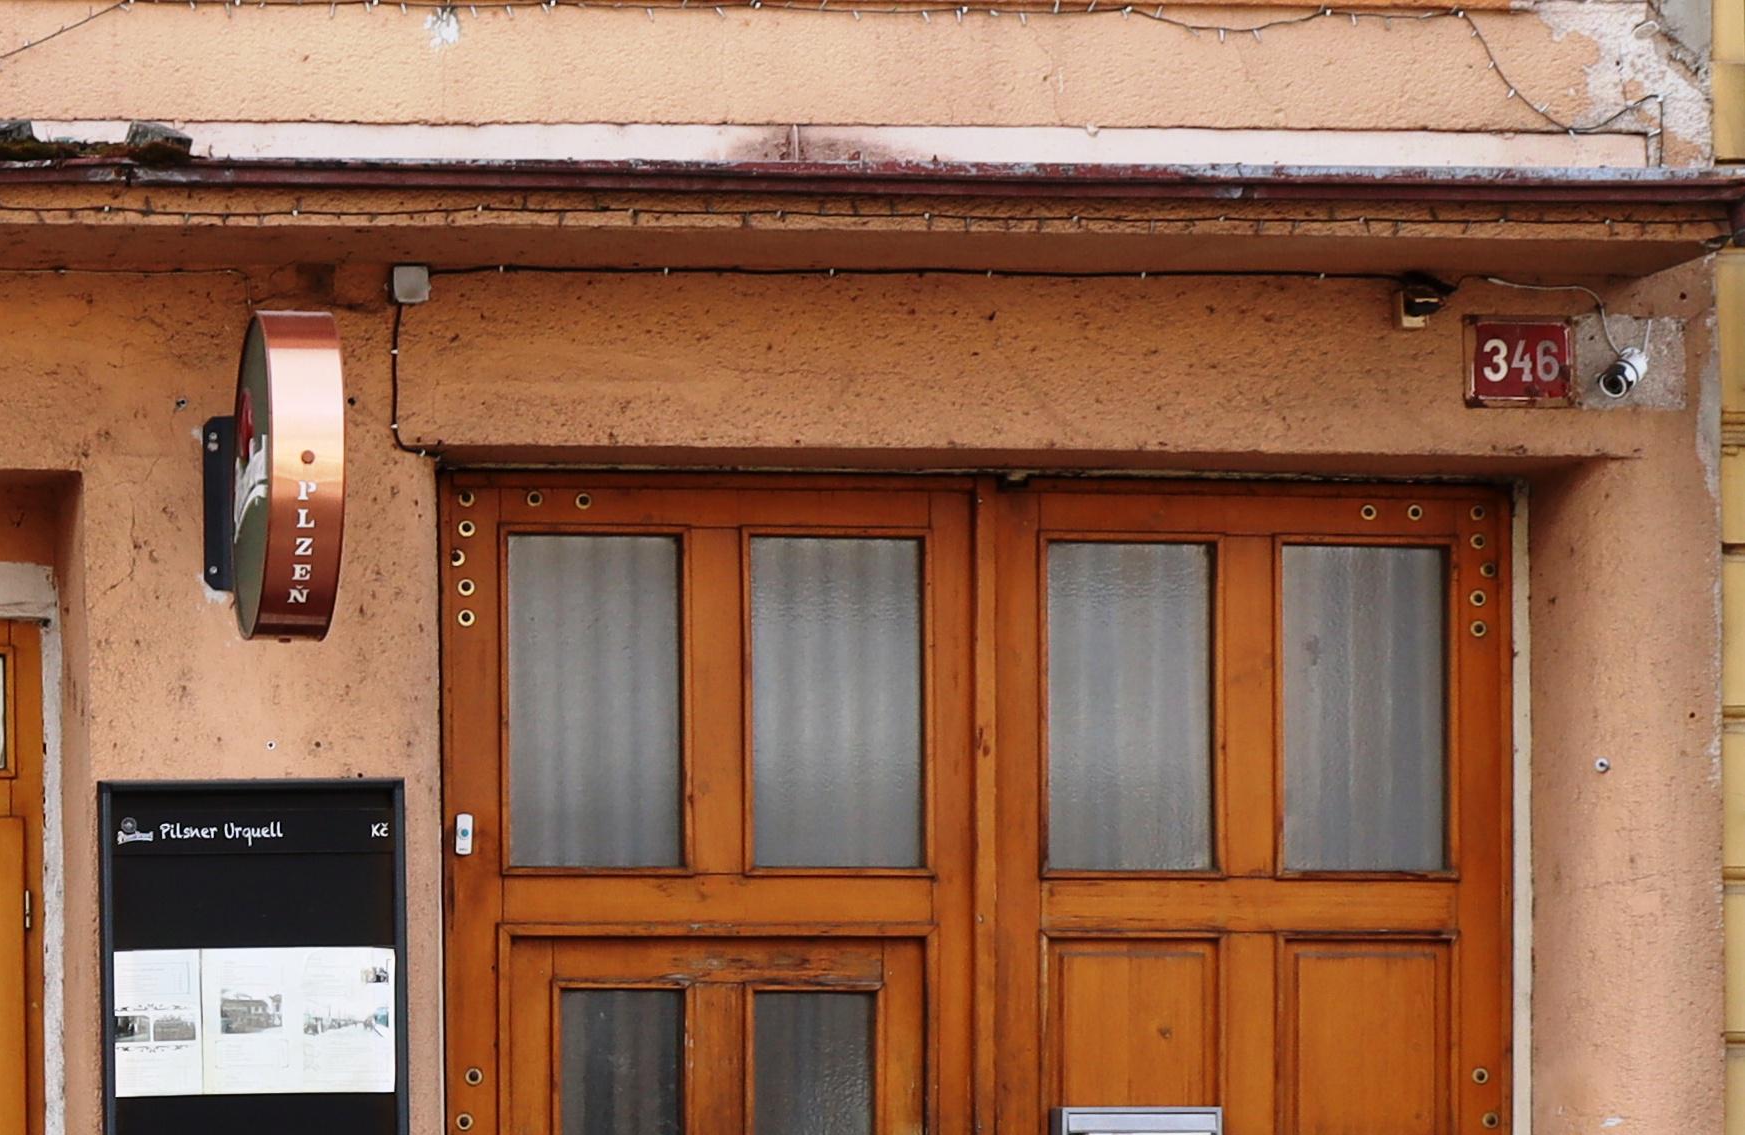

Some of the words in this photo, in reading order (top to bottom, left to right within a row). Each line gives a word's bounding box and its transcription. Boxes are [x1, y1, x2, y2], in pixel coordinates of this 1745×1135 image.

[1483, 338, 1560, 382] 346
[287, 480, 318, 604] PLZEŇ
[159, 822, 219, 840] Pilsner
[223, 821, 284, 846] Urquell
[371, 821, 389, 838] Kč
